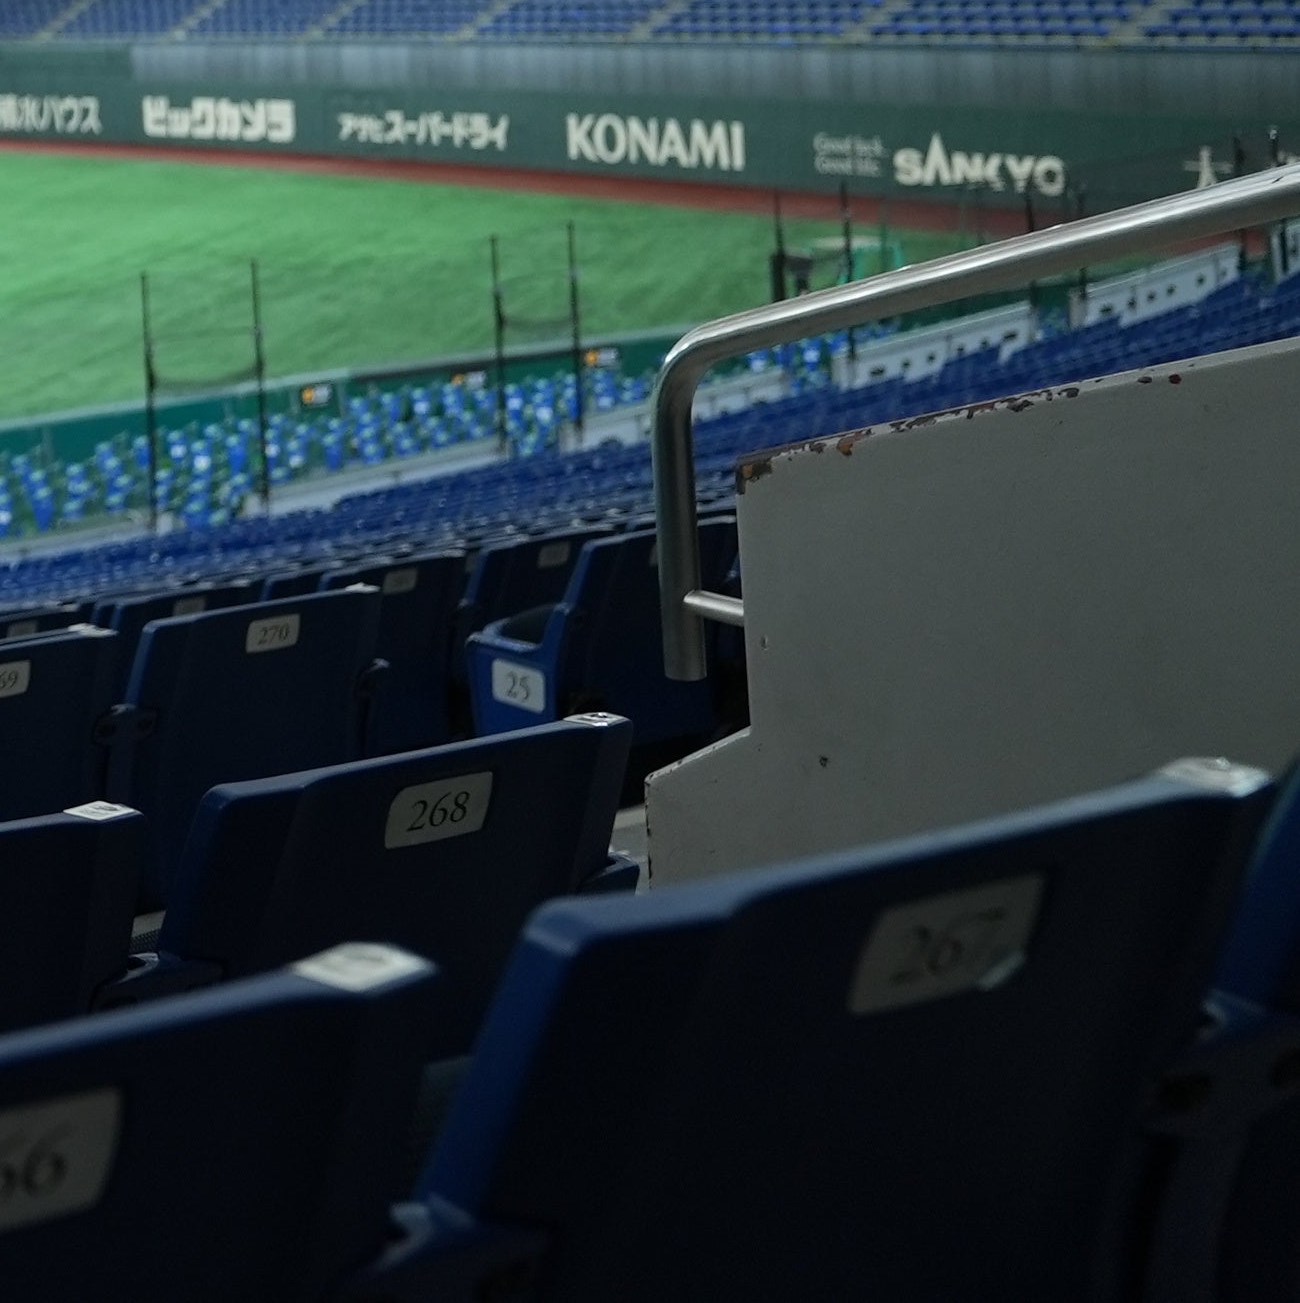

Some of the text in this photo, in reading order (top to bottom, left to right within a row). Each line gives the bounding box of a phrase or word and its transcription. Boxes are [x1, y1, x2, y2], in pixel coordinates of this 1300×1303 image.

[565, 113, 746, 172] KONAMI
[893, 132, 1066, 197] SANKYO
[258, 623, 290, 646] 270
[506, 671, 529, 700] 25
[406, 791, 470, 832] 268
